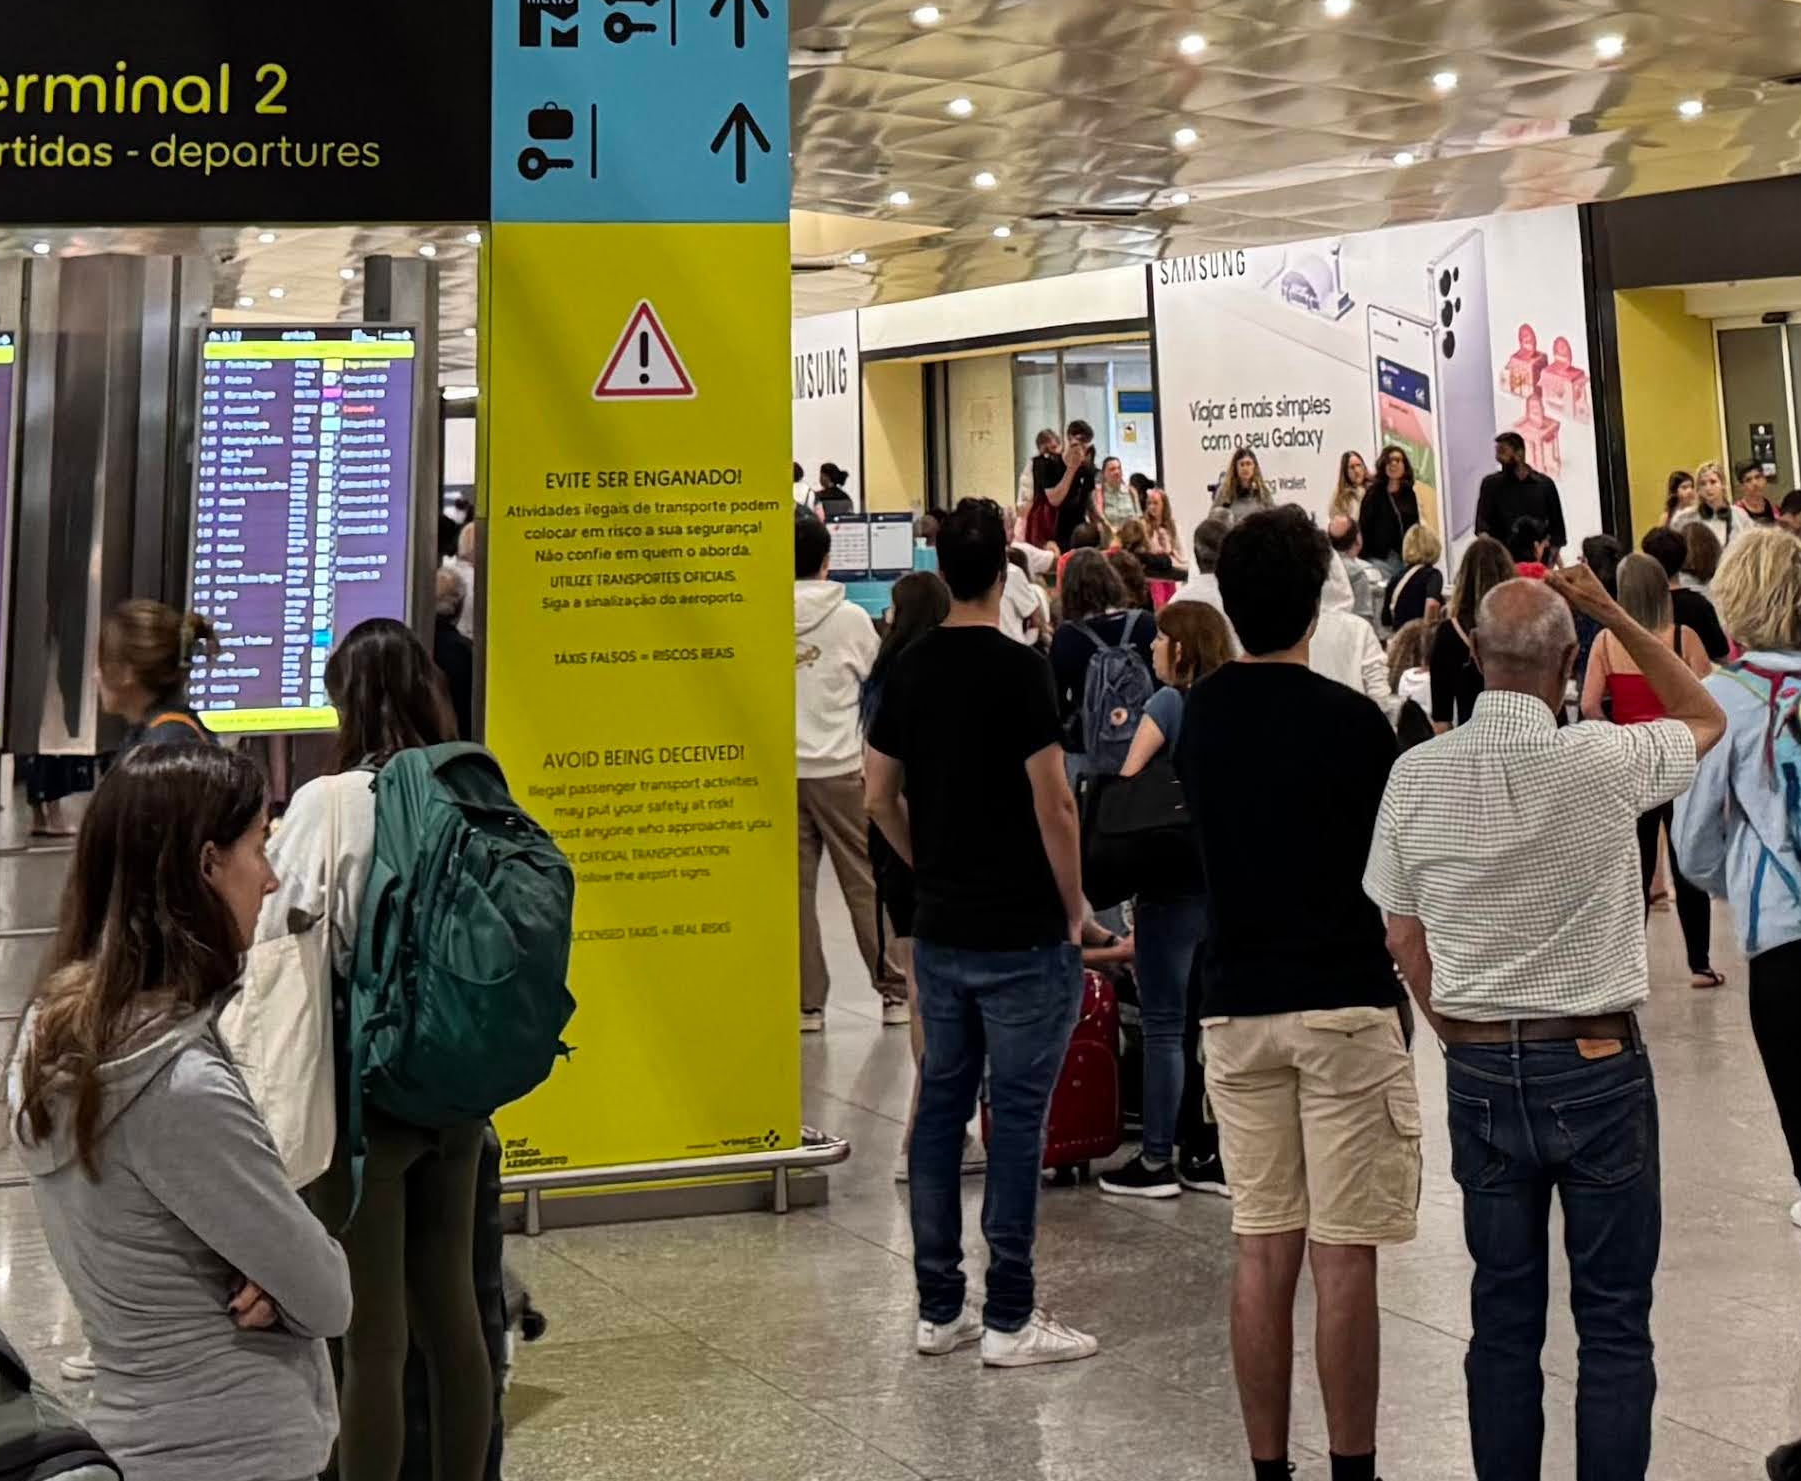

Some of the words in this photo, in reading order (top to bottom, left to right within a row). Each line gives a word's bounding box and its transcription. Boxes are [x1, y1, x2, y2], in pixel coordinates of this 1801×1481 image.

[254, 63, 289, 114] 2
[150, 133, 380, 175] departures
[1160, 250, 1246, 285] SAMSUNG
[793, 347, 847, 399] MSUNG
[1189, 398, 1225, 427] Viajar
[1229, 397, 1237, 419] é
[1241, 396, 1272, 418] mais
[1276, 395, 1331, 423] simples
[1201, 432, 1232, 452] com
[1234, 431, 1242, 449] o
[1246, 428, 1269, 450] seu
[1272, 427, 1323, 453] Galaxy
[546, 472, 591, 489] EVITE
[597, 471, 628, 488] SER
[634, 469, 742, 487] ENGANADO!
[507, 504, 580, 517] Atividades
[584, 502, 629, 518] ilegais
[633, 501, 651, 514] de
[655, 501, 726, 515] transporte
[730, 499, 779, 514] podem
[525, 527, 576, 540] colocar
[581, 527, 604, 538] em
[608, 525, 642, 538] risco
[645, 526, 655, 536] a
[658, 524, 683, 536] sua
[687, 521, 762, 538] segurança!
[535, 550, 563, 562] Não
[567, 548, 611, 561] confie
[616, 548, 639, 560] em
[642, 547, 683, 561] quem
[686, 547, 696, 557] o
[550, 575, 592, 588] UTILIZE
[598, 572, 680, 586] TRANSPORTES
[542, 597, 570, 611] Siga
[573, 598, 582, 608] a
[585, 594, 656, 607] sinalização
[660, 594, 676, 605] do
[590, 651, 637, 664] FALSOS
[653, 648, 698, 661] RISCOS
[701, 647, 735, 660] REAIS
[543, 751, 599, 769] AVOID
[604, 748, 654, 766] BEING
[659, 744, 745, 763] DECEIVED!
[528, 784, 566, 800] Illegal
[569, 781, 637, 798] passenger
[640, 778, 701, 792] transport
[703, 776, 758, 789] activities
[554, 806, 584, 818] may
[587, 804, 610, 818] put
[614, 803, 643, 817] your
[647, 800, 688, 814] safety
[692, 799, 705, 810] at
[708, 797, 734, 810] risk!
[584, 825, 634, 840] anyone
[637, 823, 664, 835] who
[668, 821, 744, 834] approaches
[615, 870, 634, 881] the
[637, 868, 678, 881] airport
